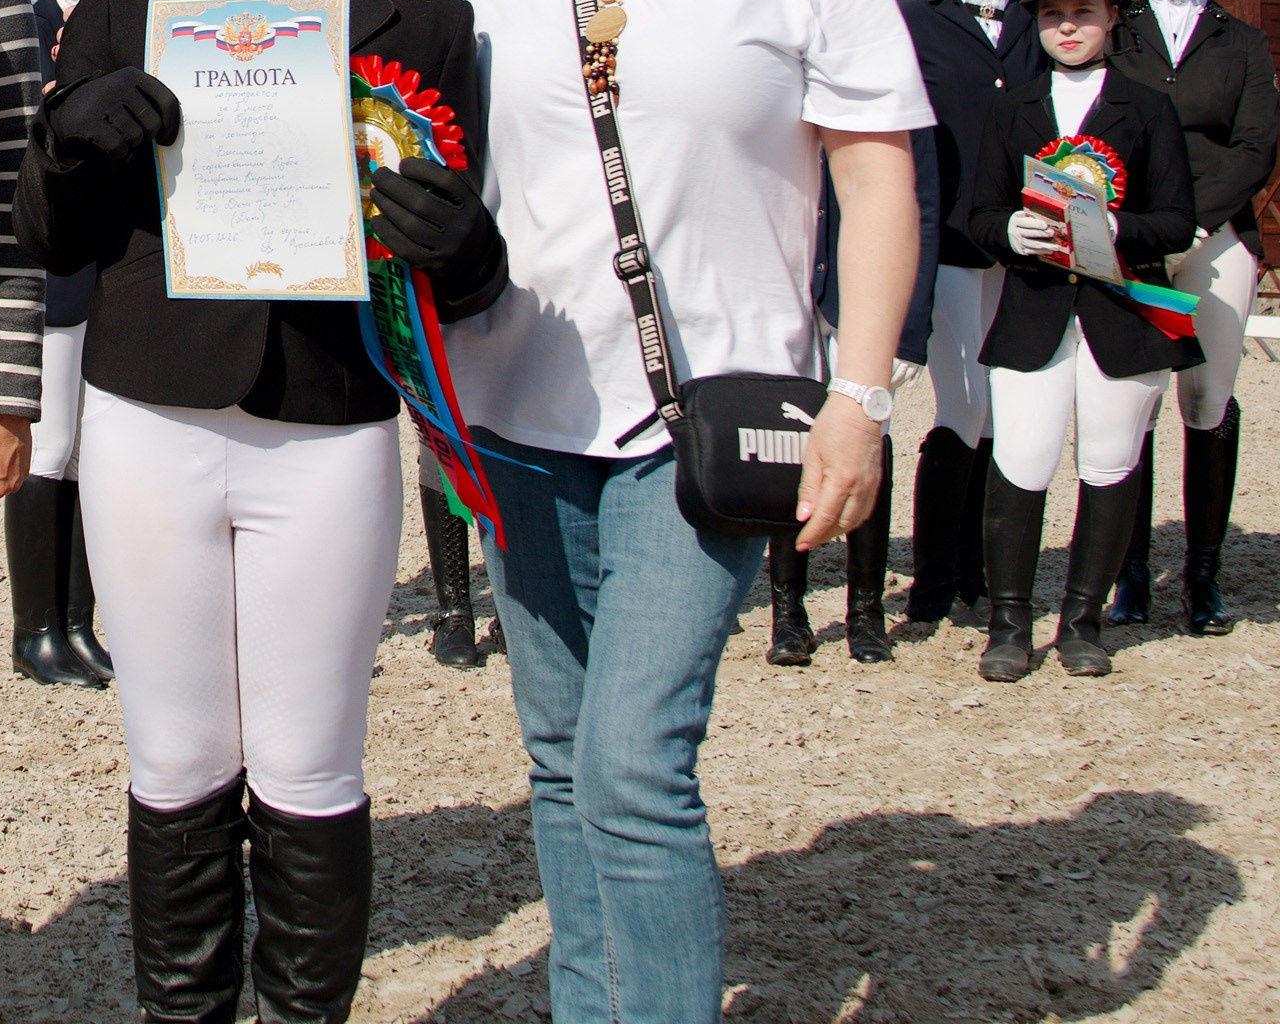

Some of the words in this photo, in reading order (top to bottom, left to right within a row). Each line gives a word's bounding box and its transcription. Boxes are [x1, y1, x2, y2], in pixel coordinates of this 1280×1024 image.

[194, 68, 298, 88] ГРАМОТА
[602, 146, 629, 206] PUMA
[386, 260, 411, 326] 2026
[637, 314, 664, 374] PUMA
[433, 436, 455, 470] ПО
